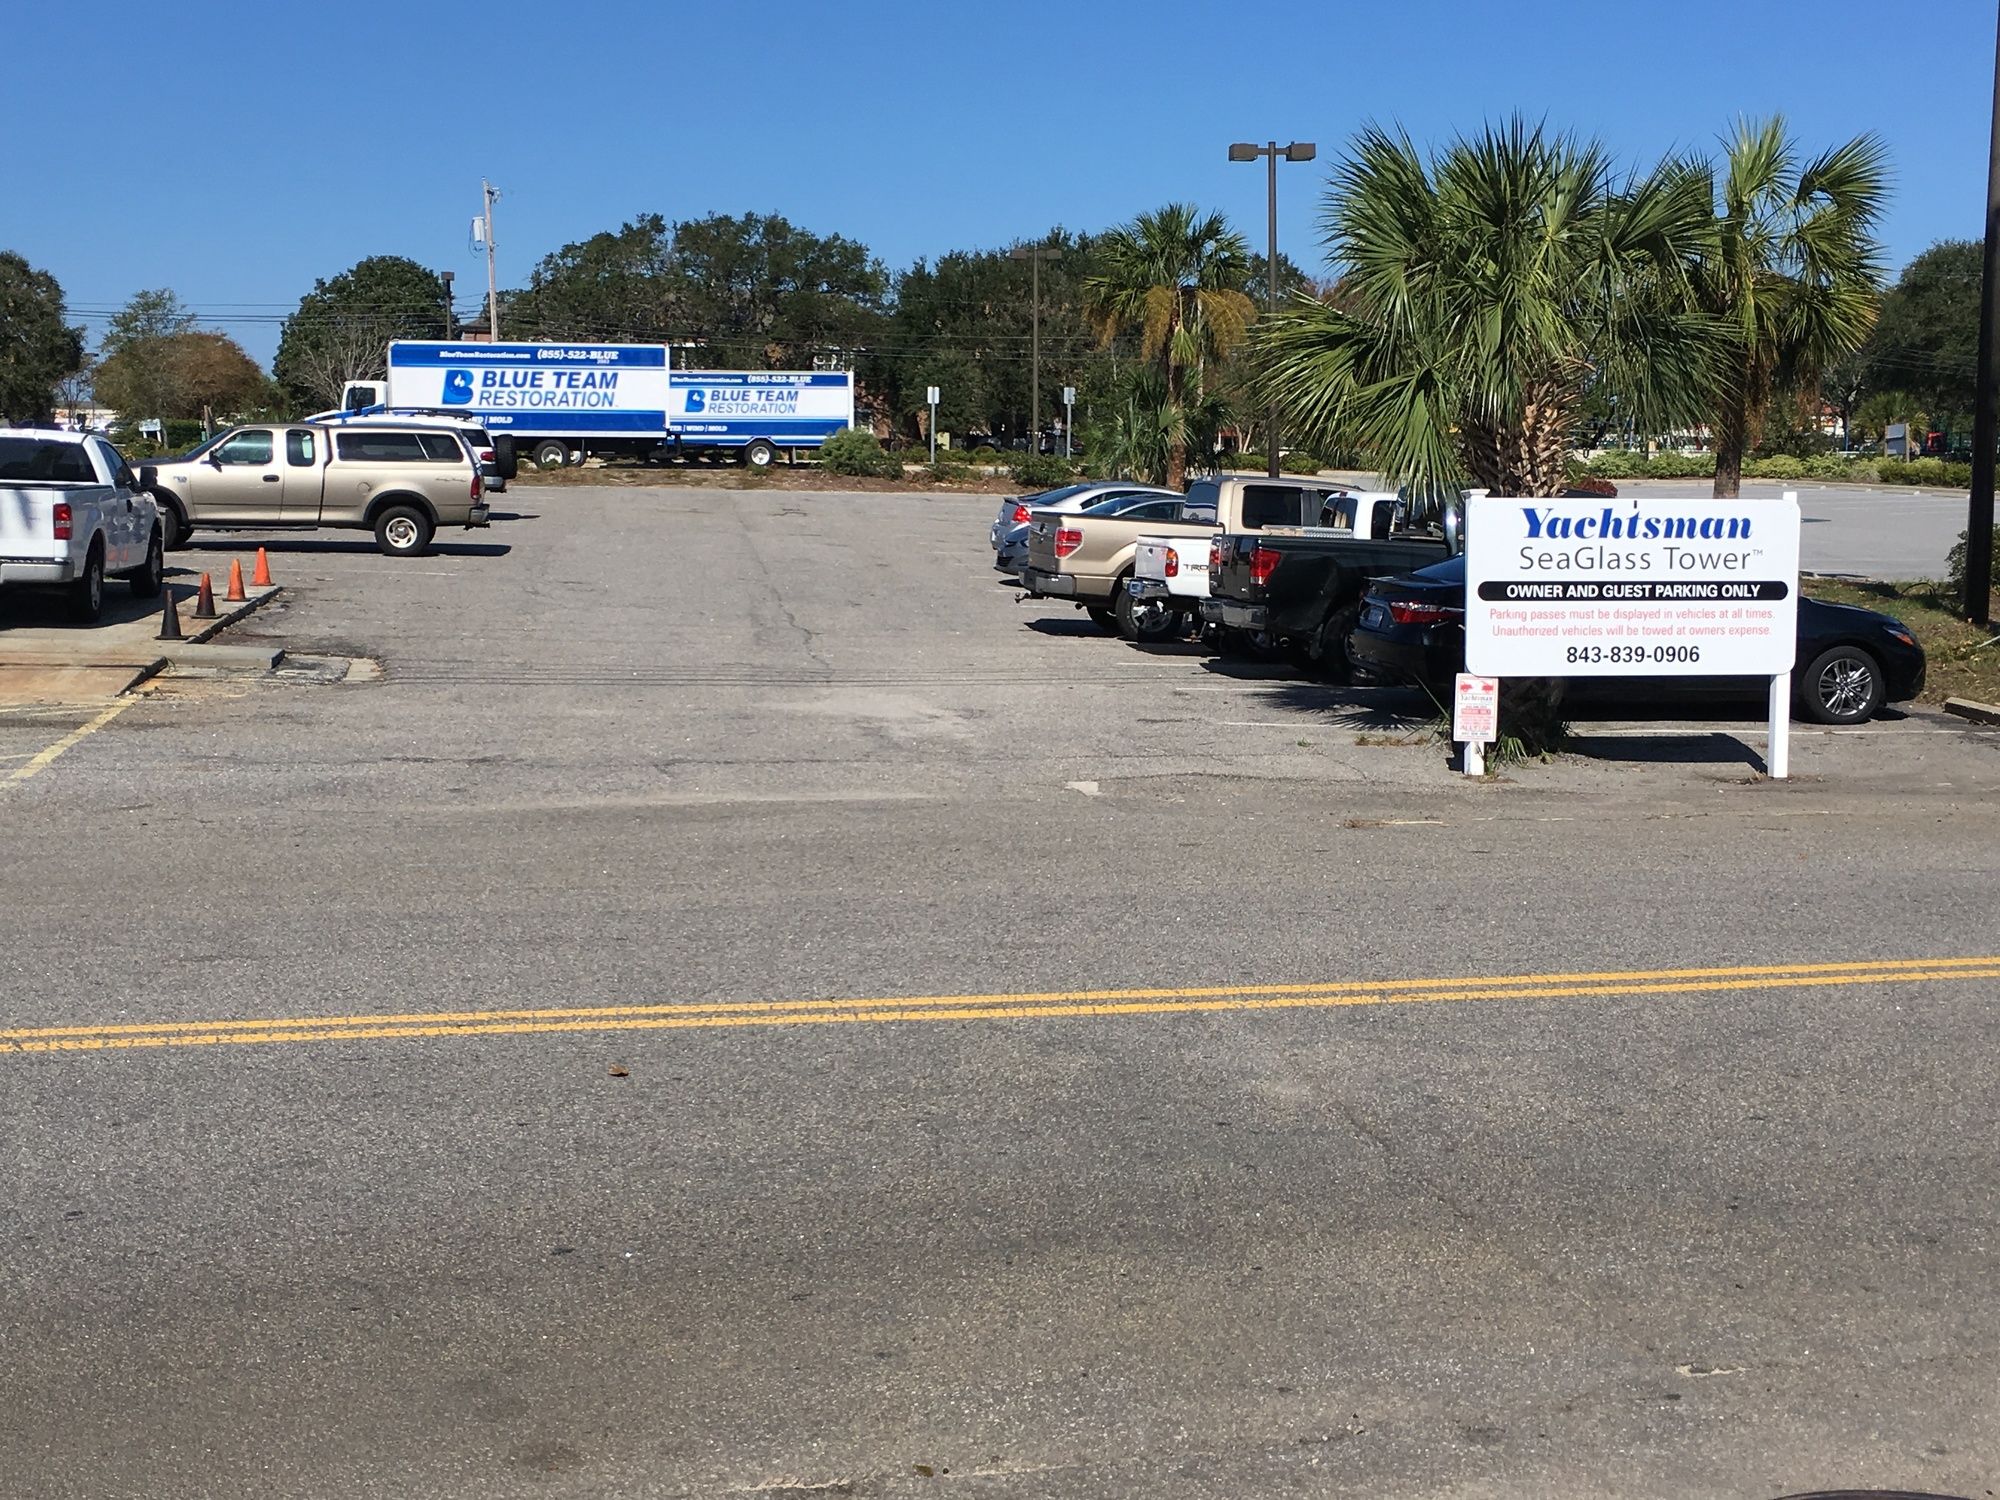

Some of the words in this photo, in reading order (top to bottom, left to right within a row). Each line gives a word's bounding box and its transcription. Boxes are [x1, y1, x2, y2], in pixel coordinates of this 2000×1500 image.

[537, 348, 619, 360] (855)-522-BLUE
[482, 371, 544, 388] BLUE
[553, 372, 618, 389] TEAM
[478, 391, 615, 407] RESTORATION
[710, 390, 751, 401] BLUE
[756, 390, 799, 402] TEAM
[708, 403, 797, 414] RESTORATION
[489, 416, 514, 424] MOLD
[1520, 507, 1754, 540] Yachtsman
[1519, 546, 1651, 570] SeaGlass
[1506, 584, 1563, 598] OWNER
[1566, 584, 1599, 598] AND
[1602, 584, 1652, 598] GUEST
[1655, 584, 1718, 598] PARKING
[1721, 584, 1761, 598] ONLY
[1490, 608, 1527, 622] Parking
[1530, 609, 1566, 622] passes
[1569, 609, 1594, 619] must
[1598, 608, 1610, 619] be
[1613, 608, 1660, 620] displayed
[1664, 608, 1672, 619] in
[1676, 608, 1716, 619] vehicles
[1719, 609, 1728, 619] at
[1731, 608, 1742, 619] all
[1745, 608, 1775, 619] times.
[1492, 625, 1558, 636] Unauthorized
[1562, 625, 1603, 636] vehicles
[1606, 625, 1623, 635] will
[1626, 625, 1639, 636] be
[1642, 625, 1674, 636] towed
[1676, 626, 1686, 635] at
[1689, 627, 1725, 635] owners
[1567, 646, 1700, 663] 843-839-0906
